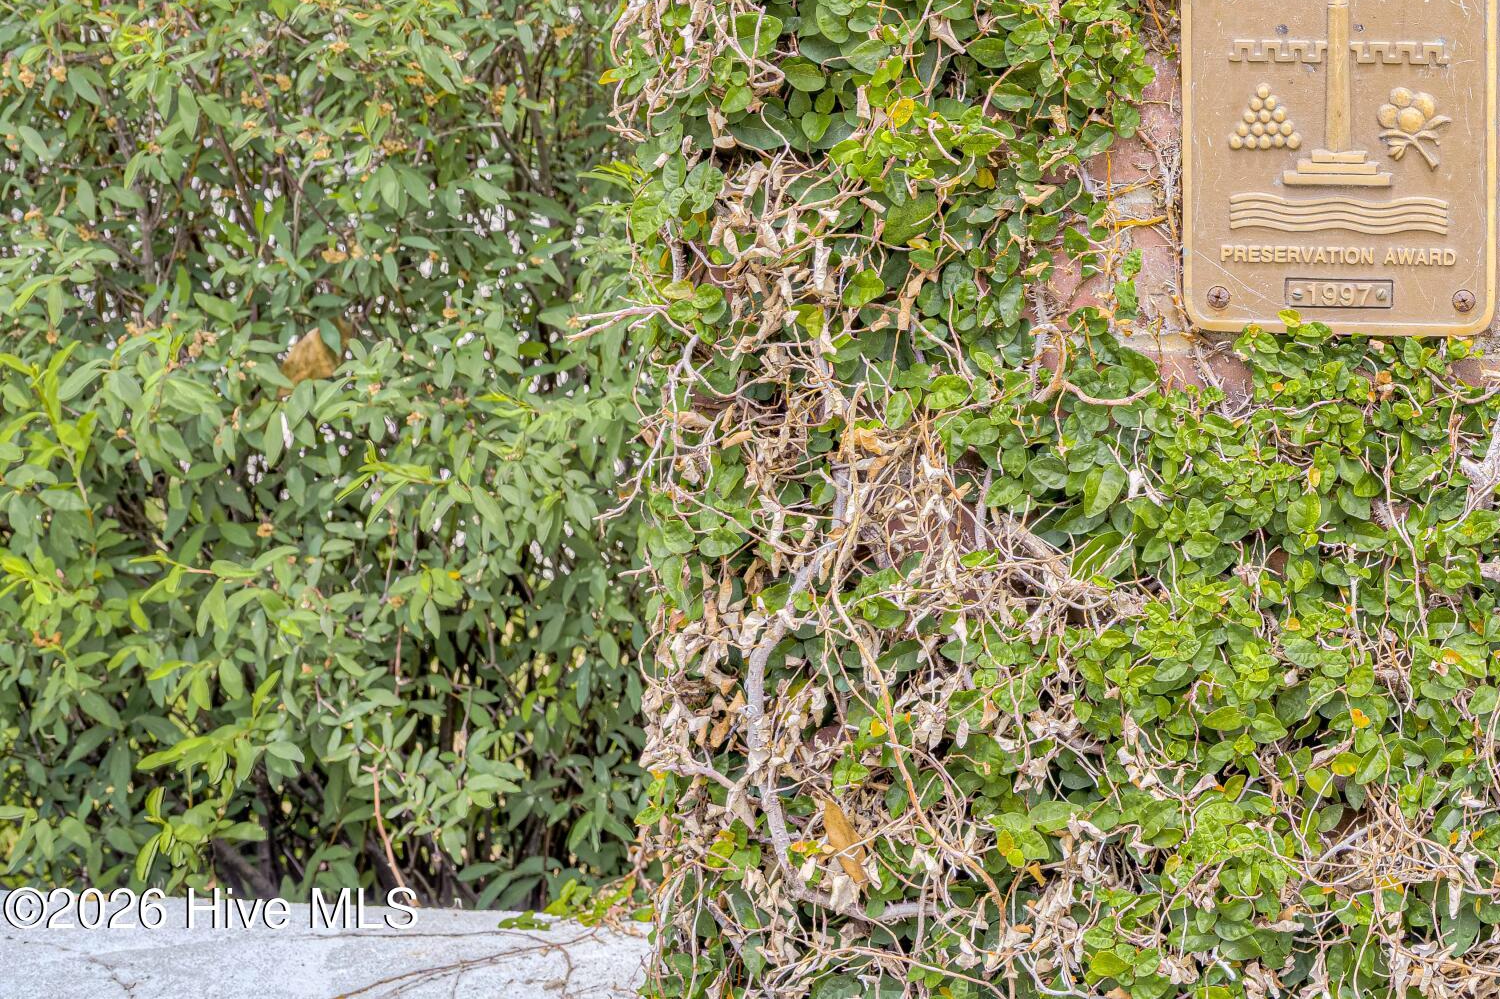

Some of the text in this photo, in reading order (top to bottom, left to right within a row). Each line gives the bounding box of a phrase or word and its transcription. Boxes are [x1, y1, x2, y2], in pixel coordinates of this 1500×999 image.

[1220, 245, 1457, 266] PRESERVATION AWARD
[1306, 282, 1372, 306] 1997
